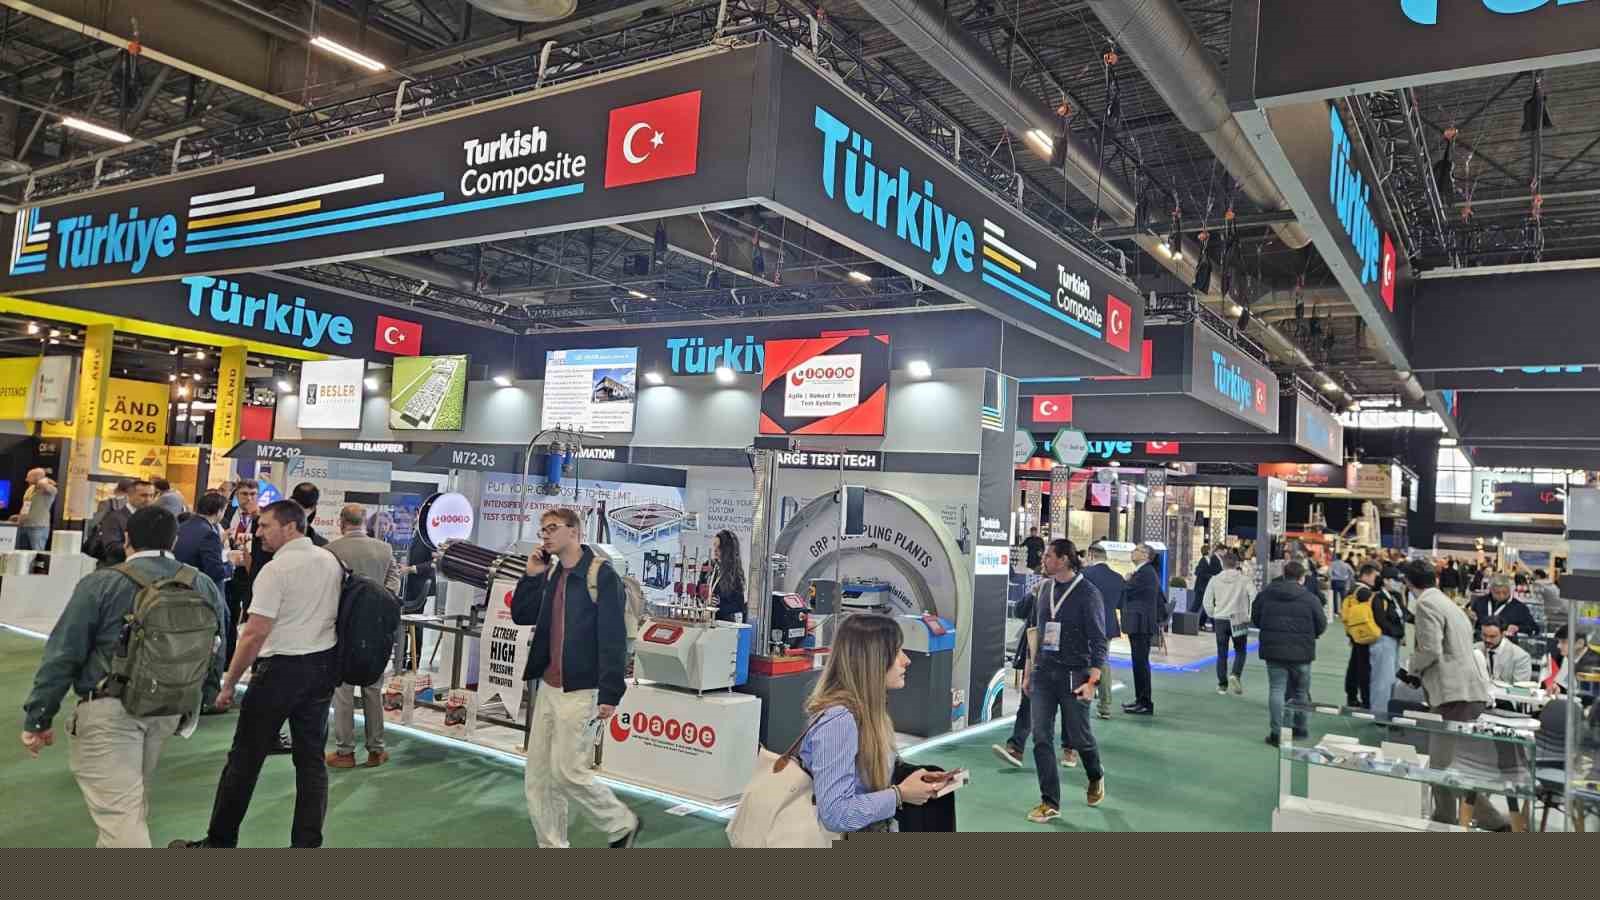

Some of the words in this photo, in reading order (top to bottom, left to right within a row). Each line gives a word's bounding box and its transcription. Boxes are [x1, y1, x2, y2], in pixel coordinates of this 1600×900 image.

[464, 125, 548, 166] Turkish
[460, 152, 587, 197] Composite
[815, 105, 975, 275] Türkiye
[57, 207, 178, 275] Türkiye
[1057, 264, 1091, 301] Turkish
[181, 275, 353, 348] Türkiye
[1056, 293, 1103, 330] Composite
[319, 384, 356, 397] BESLER
[1211, 351, 1252, 412] Türkiye
[109, 418, 157, 434] 2026
[224, 415, 232, 438] THE
[257, 445, 301, 458] M72-02
[452, 450, 496, 466] M72-03
[810, 454, 841, 466] TEST
[843, 455, 876, 467] TECH
[488, 480, 505, 492] PUT
[484, 512, 500, 521] TEST
[980, 528, 1008, 542] Composite
[809, 535, 829, 558] GRP
[894, 530, 934, 568] PLANTS
[492, 626, 519, 641] EXTREME
[490, 641, 516, 663] HIGH
[489, 662, 514, 677] PRESSURE
[488, 675, 513, 688] INTENSIFIER
[610, 711, 715, 748] alarge
